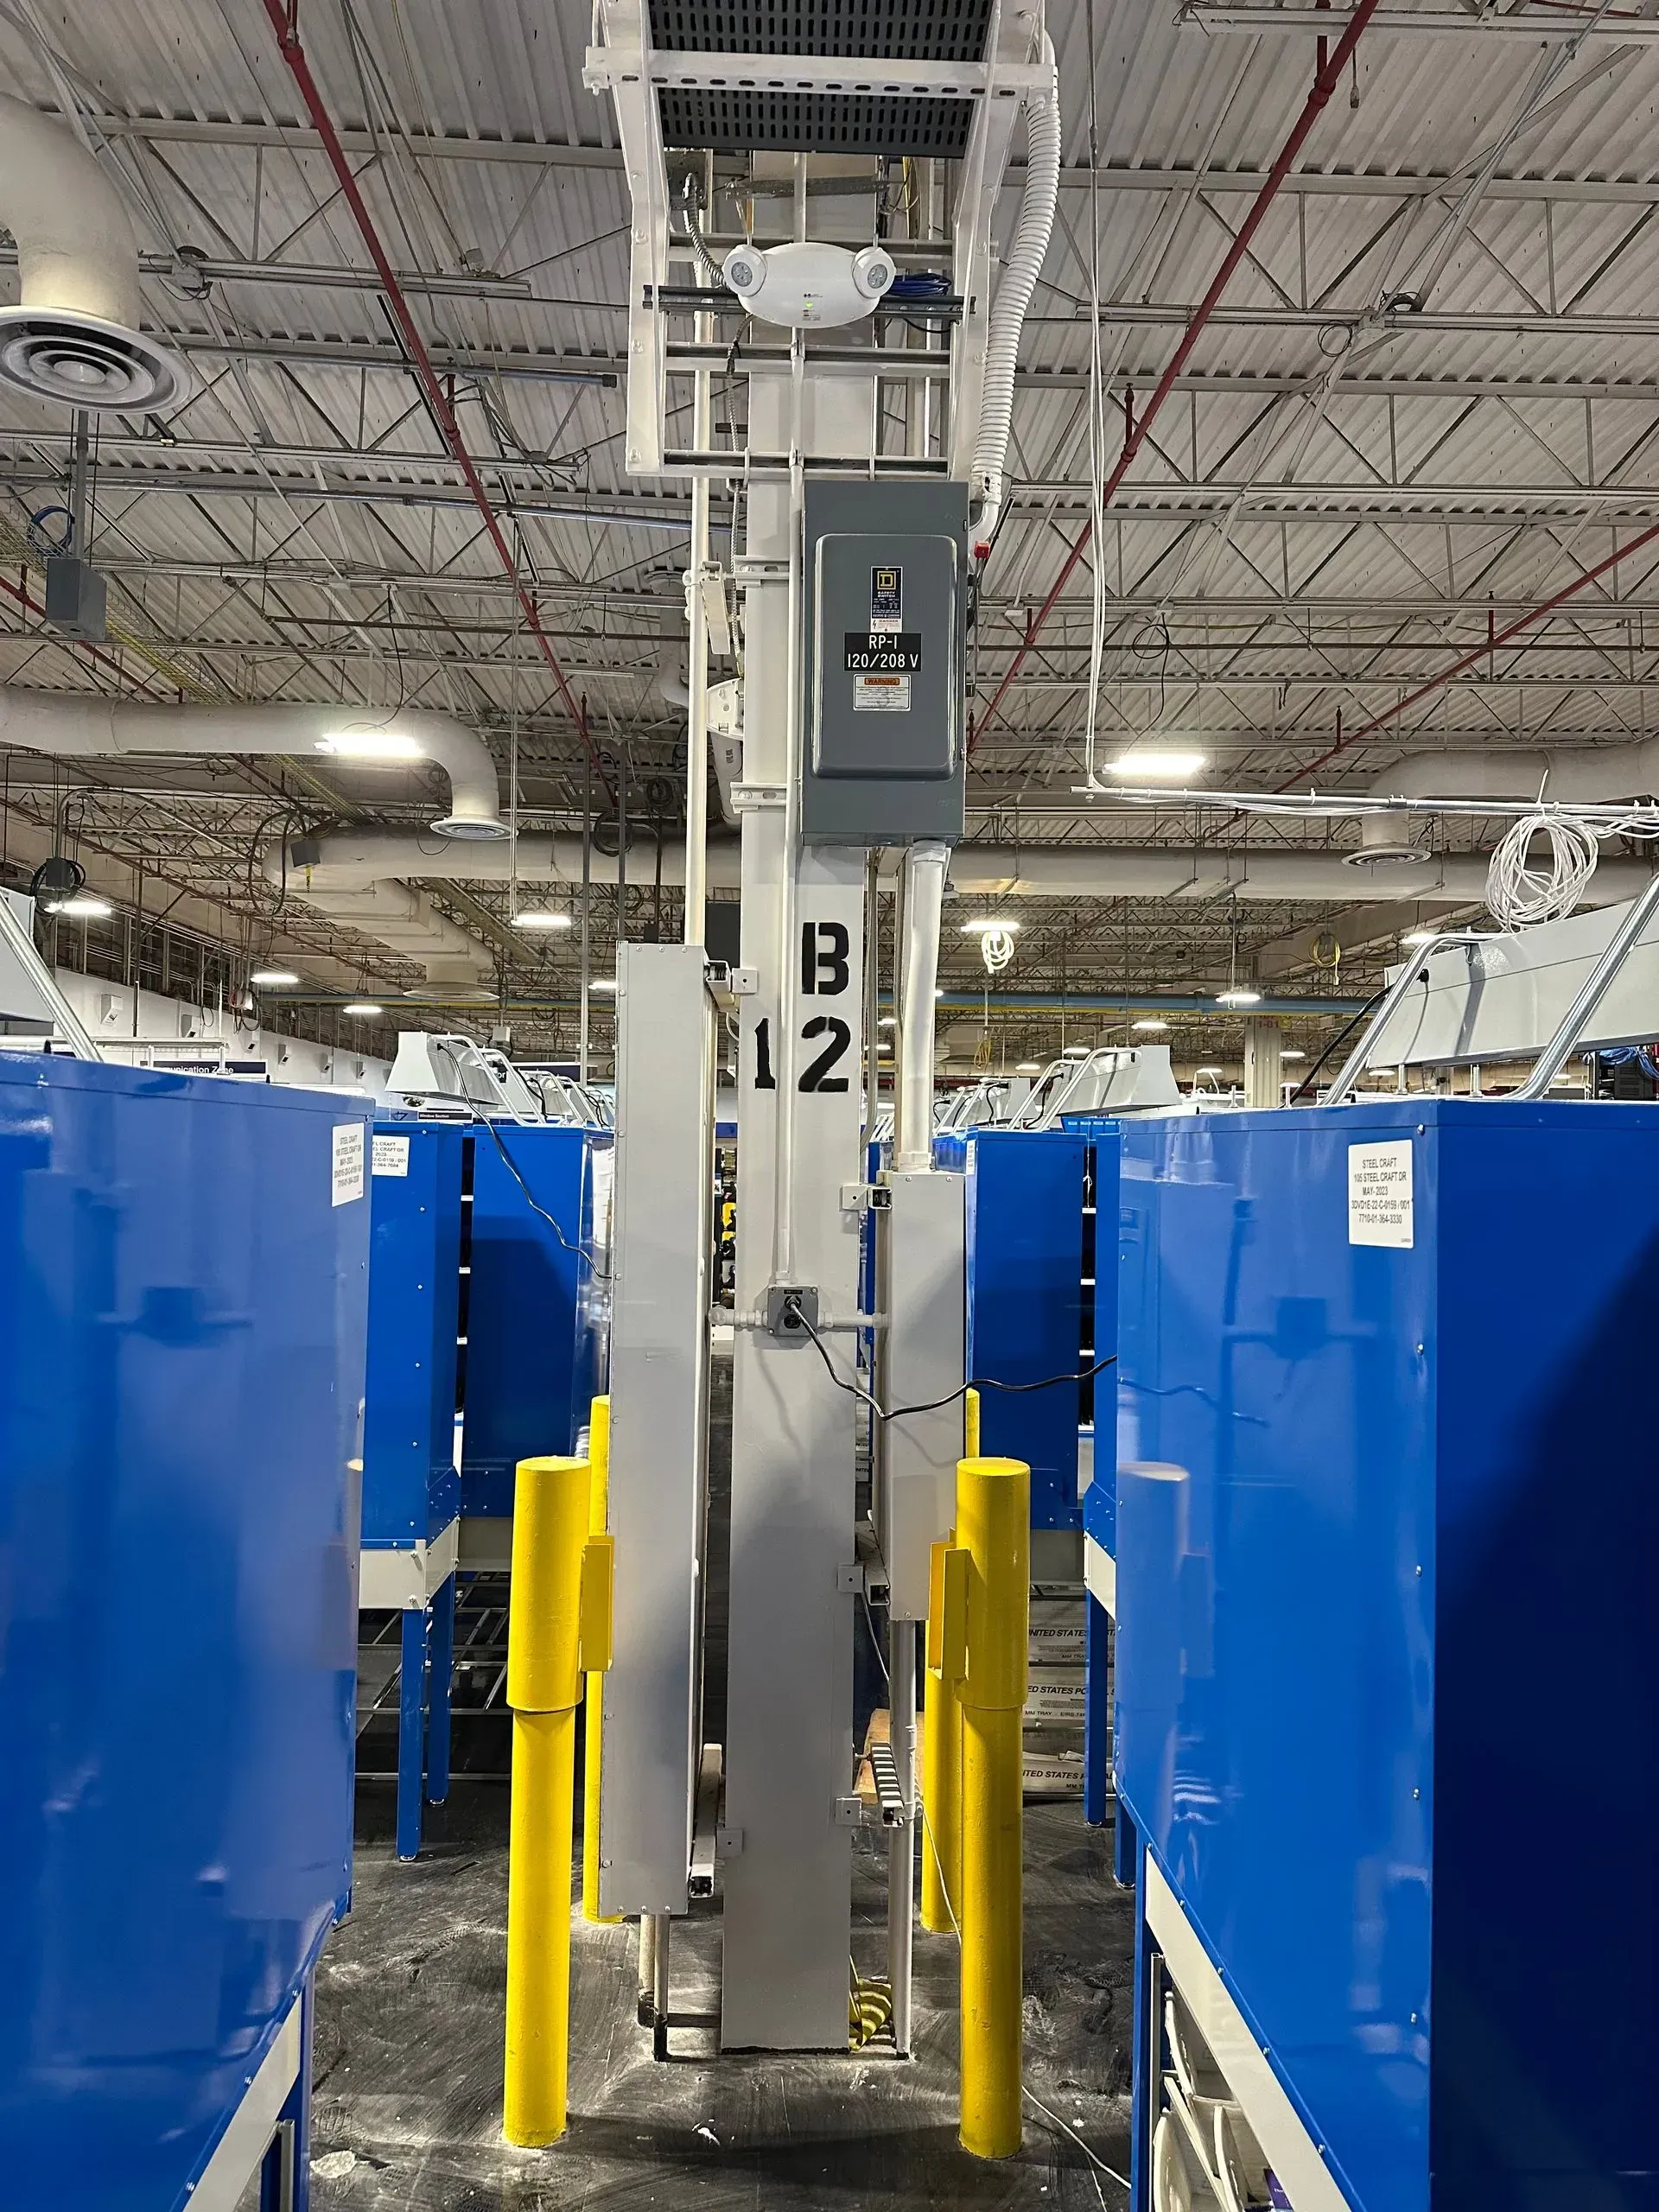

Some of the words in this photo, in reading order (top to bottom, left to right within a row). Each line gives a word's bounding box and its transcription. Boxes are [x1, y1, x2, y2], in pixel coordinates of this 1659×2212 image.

[869, 635, 897, 650] RP-1
[848, 653, 906, 668] 120/208
[909, 653, 918, 668] V
[801, 922, 849, 995] B
[1363, 1159, 1379, 1168] STEEL
[1380, 1157, 1397, 1167] CRAFT
[1363, 1173, 1380, 1182] STEEL
[1380, 1171, 1398, 1181] CRAFT
[1398, 1171, 1407, 1180] DR
[1376, 1185, 1389, 1196] 2023
[1039, 1686, 1073, 1694] STATES
[1045, 1770, 1078, 1780] STATES
